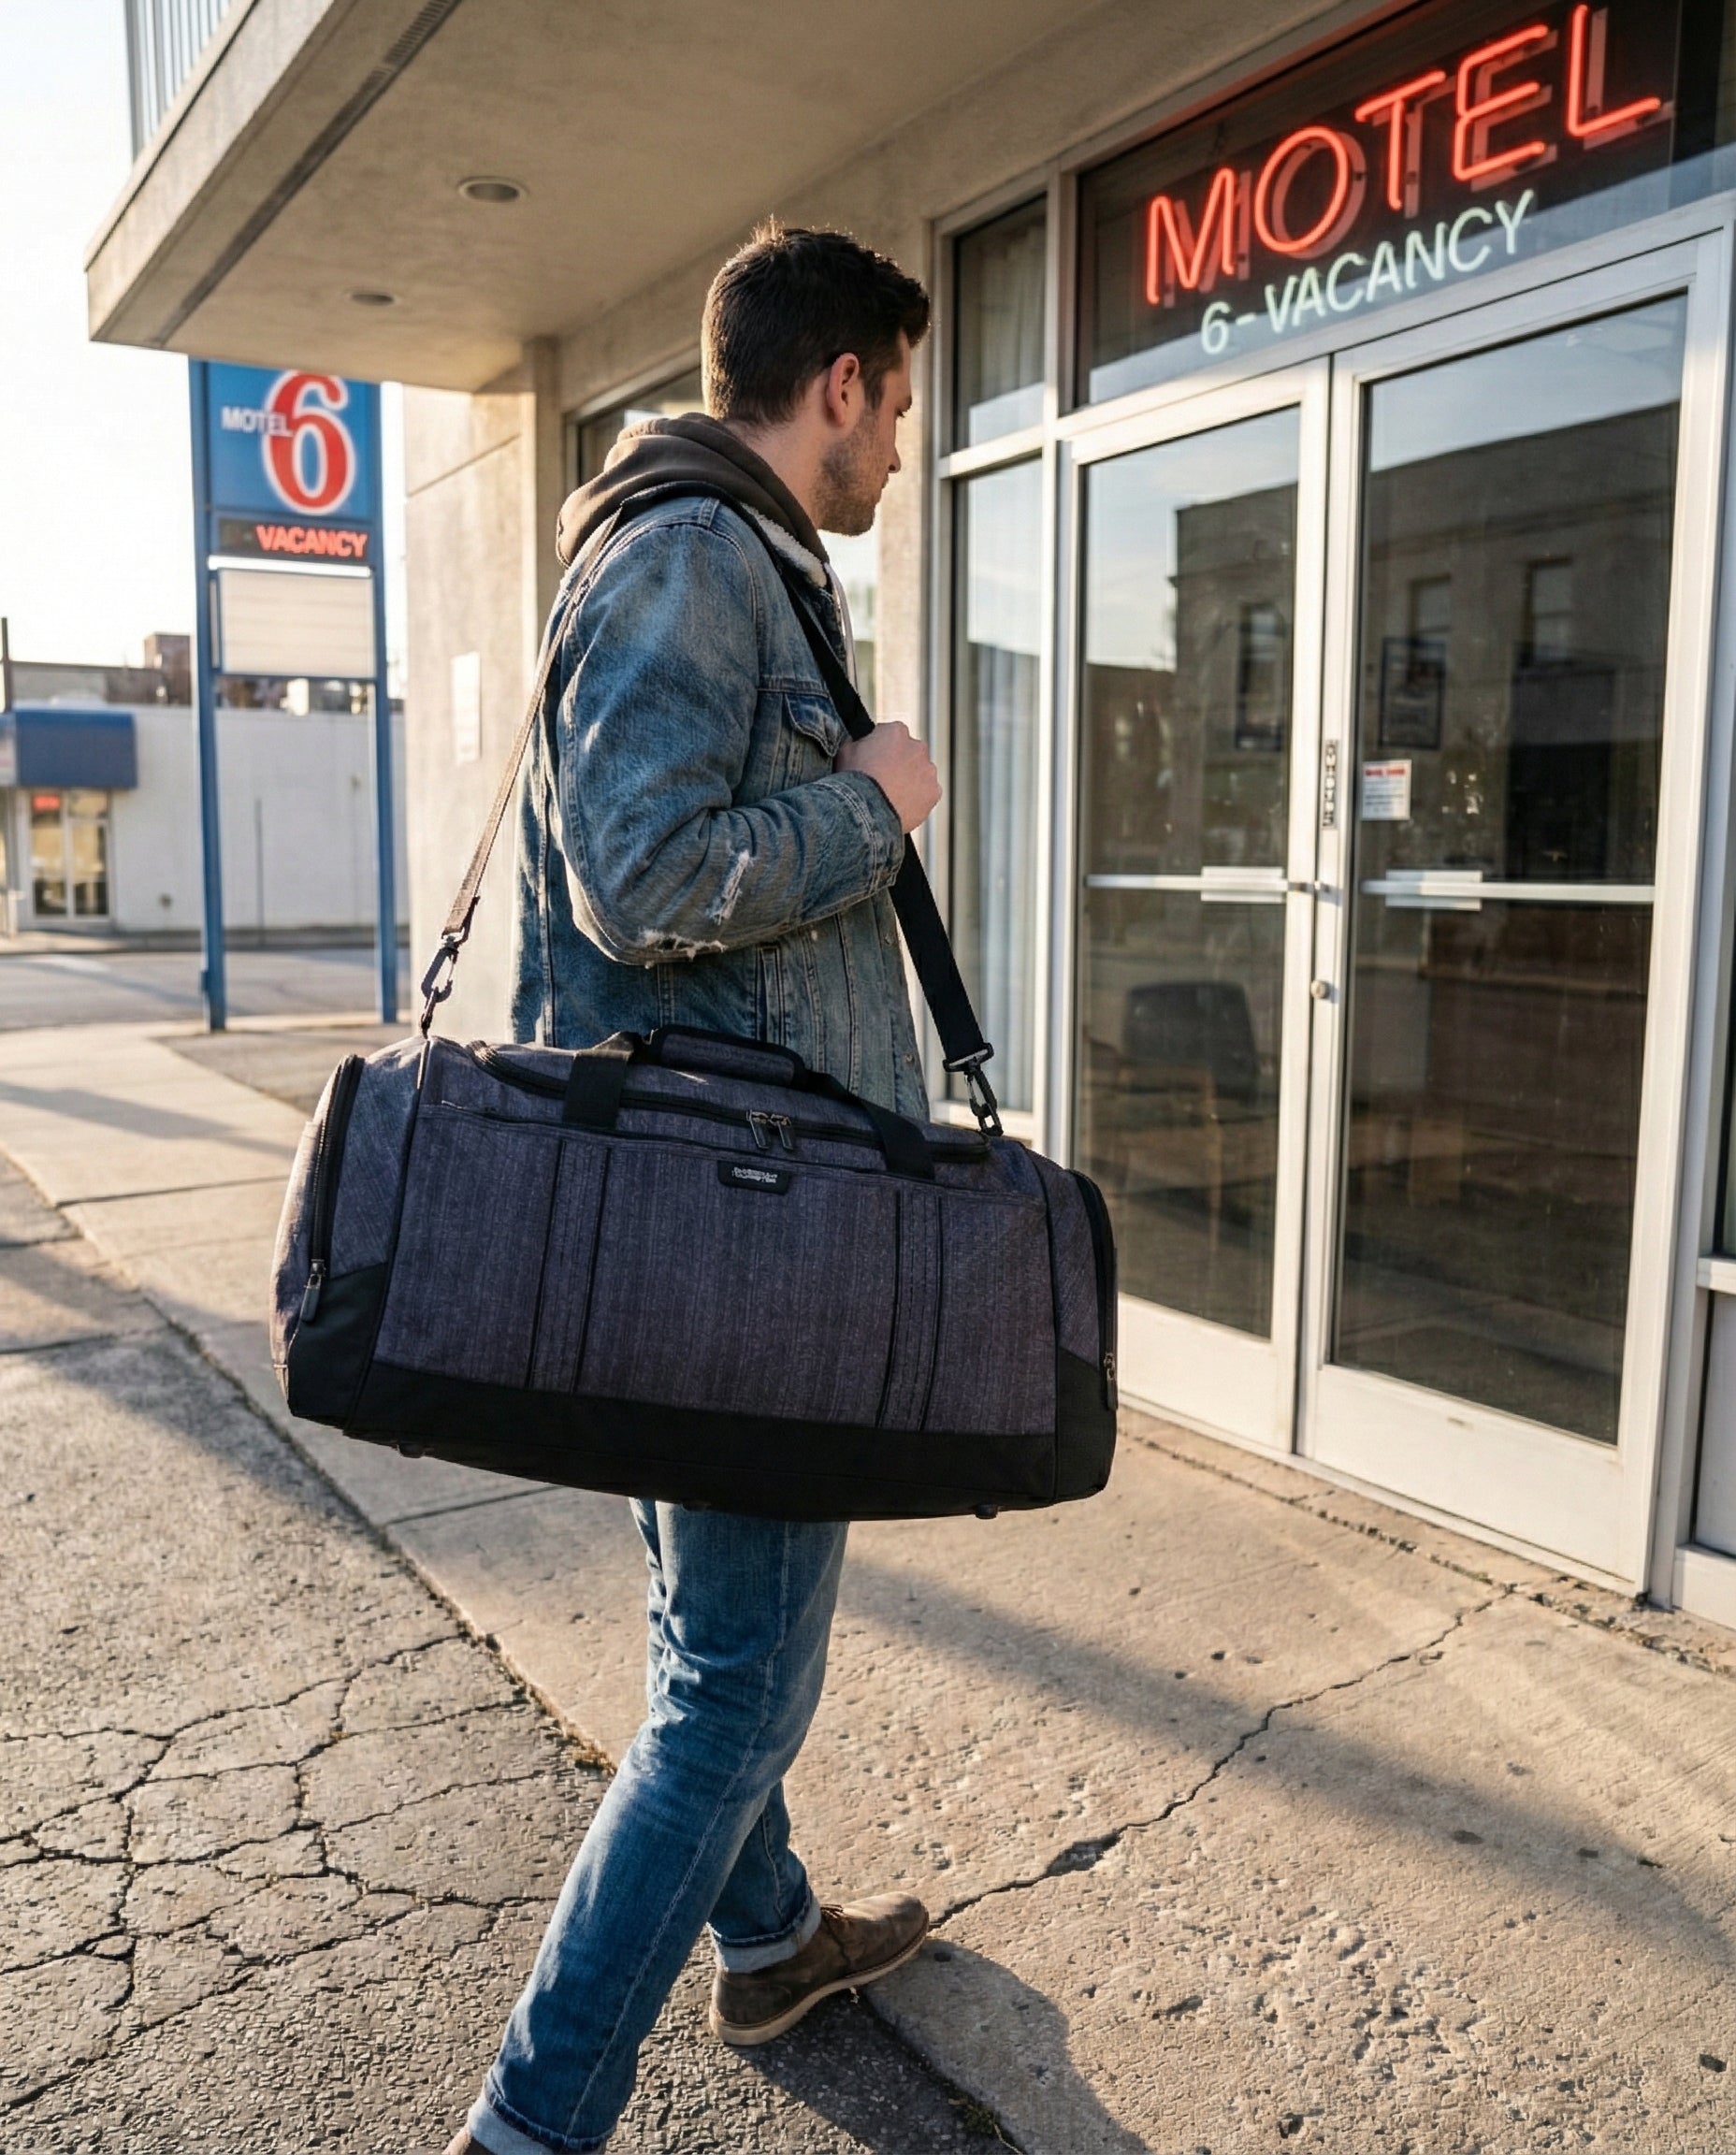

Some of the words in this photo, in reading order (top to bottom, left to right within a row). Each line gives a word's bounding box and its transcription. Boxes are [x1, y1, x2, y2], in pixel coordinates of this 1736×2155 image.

[1146, 4, 1662, 304] MOTEL
[221, 406, 295, 438] MOTEL
[262, 369, 356, 514] 6
[255, 525, 368, 557] VACANCY
